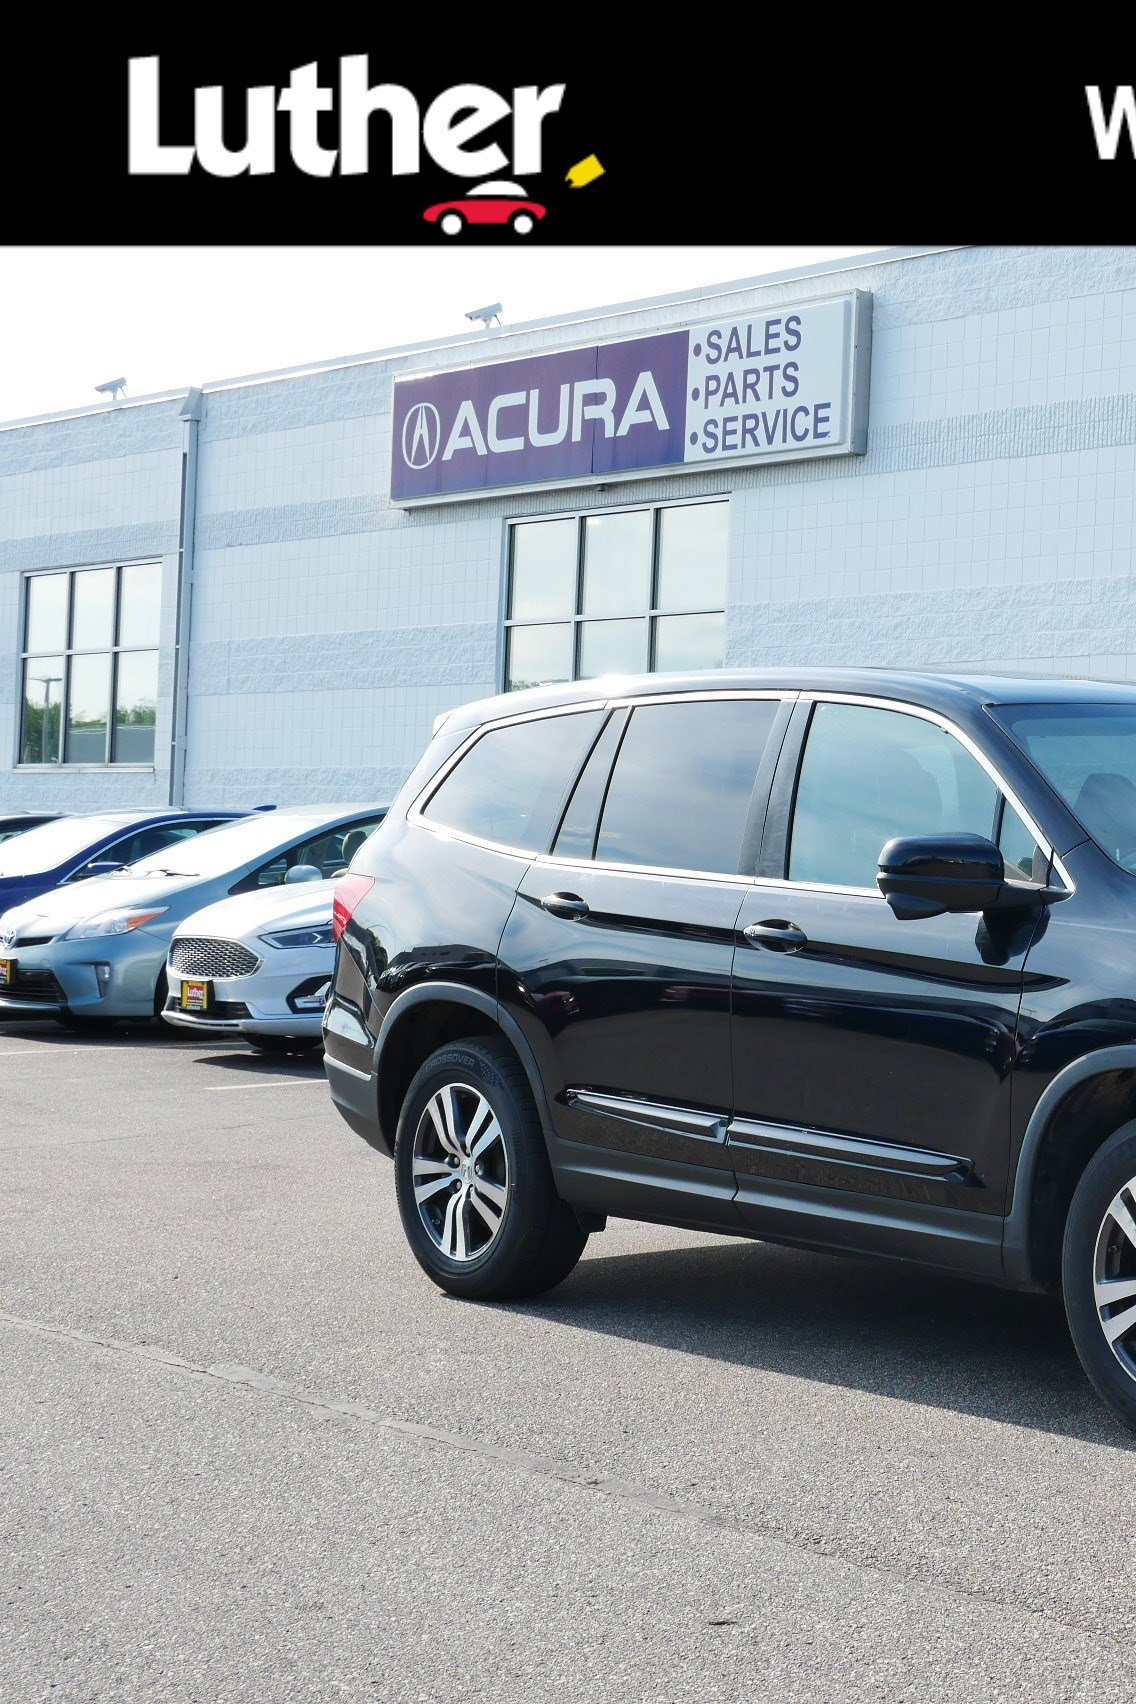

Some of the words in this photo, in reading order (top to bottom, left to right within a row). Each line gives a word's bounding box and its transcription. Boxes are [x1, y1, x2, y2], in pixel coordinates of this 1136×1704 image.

[705, 315, 802, 365] SALES
[704, 361, 800, 409] PARTS
[442, 371, 670, 461] ACURA
[702, 402, 832, 454] SERVICE
[426, 1053, 475, 1070] CROSSOVER
